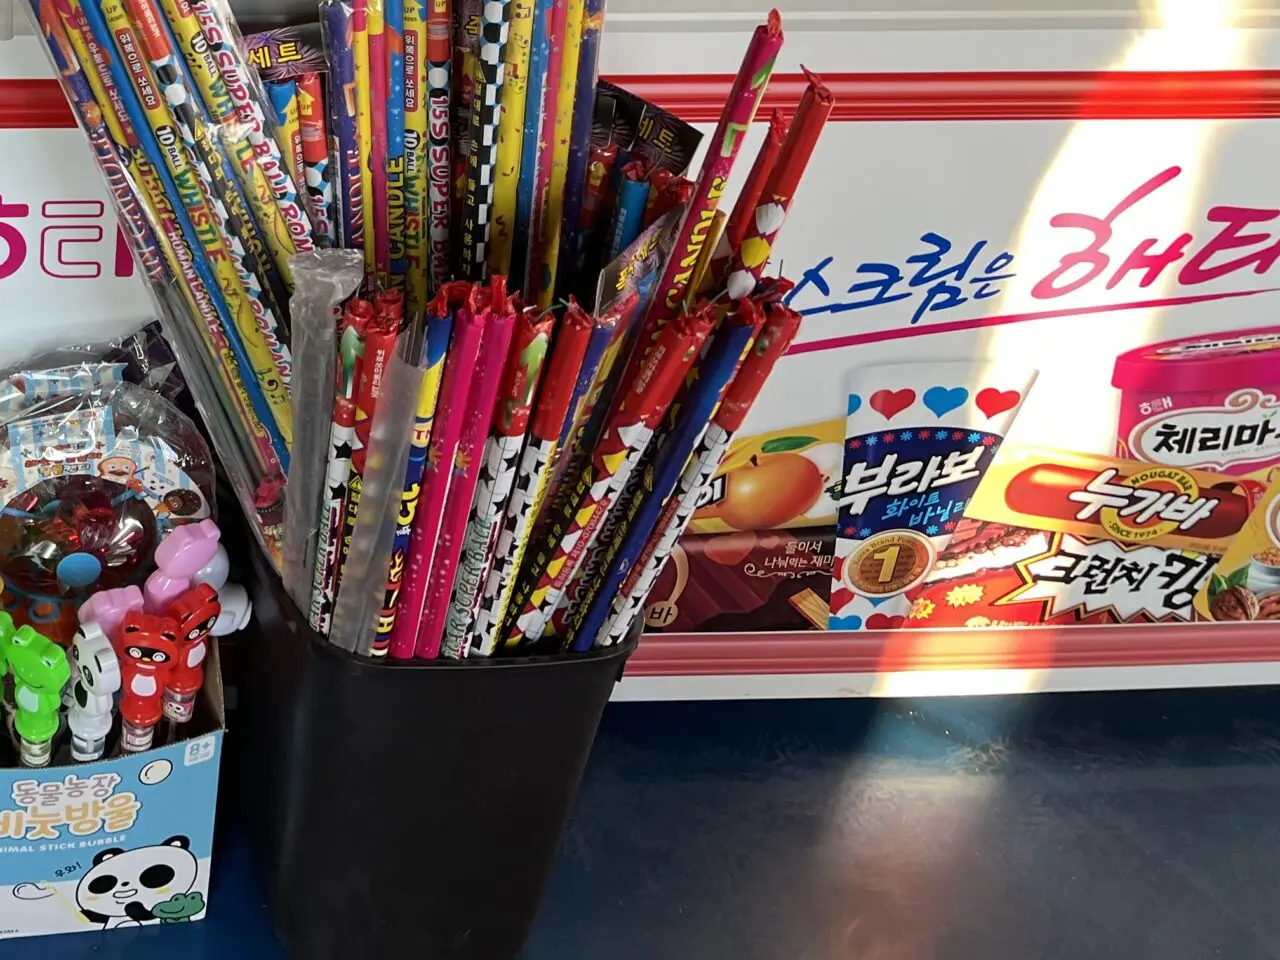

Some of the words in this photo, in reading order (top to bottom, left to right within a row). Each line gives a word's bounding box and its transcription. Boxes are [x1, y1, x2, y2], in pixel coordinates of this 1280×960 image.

[118, 32, 145, 75] 위쪽으로
[191, 33, 209, 54] 10
[203, 50, 220, 78] BALL
[248, 41, 304, 69] 세트
[404, 35, 416, 75] 위쪽으로
[404, 78, 416, 110] 쏘세요
[216, 50, 264, 134] SUPER
[253, 139, 289, 200] BALL
[431, 96, 450, 140] 15S
[155, 127, 176, 146] 10
[167, 145, 184, 171] BALL
[403, 130, 418, 150] 10
[406, 151, 416, 174] BALL
[431, 147, 450, 229] SUPER
[175, 170, 228, 265] WHISTLE
[387, 155, 405, 262] CANDLE
[1152, 418, 1280, 456] 체리마
[838, 445, 983, 517] 부라보
[1069, 468, 1221, 531] 누가바
[1131, 470, 1173, 487] NOUGAT
[1174, 472, 1195, 493] BAR
[881, 490, 941, 522] 화이트
[463, 516, 491, 562] BALL
[785, 540, 822, 555] 둘이서
[1109, 521, 1132, 539] SINCE
[873, 545, 901, 583] 1
[1032, 548, 1158, 596] 크런치
[1159, 551, 1221, 611] 킹
[450, 558, 481, 618] SUPER
[187, 739, 212, 757] 8+
[14, 774, 120, 806] 동물농장
[39, 839, 76, 853] STICK
[79, 835, 127, 849] BUBBLE
